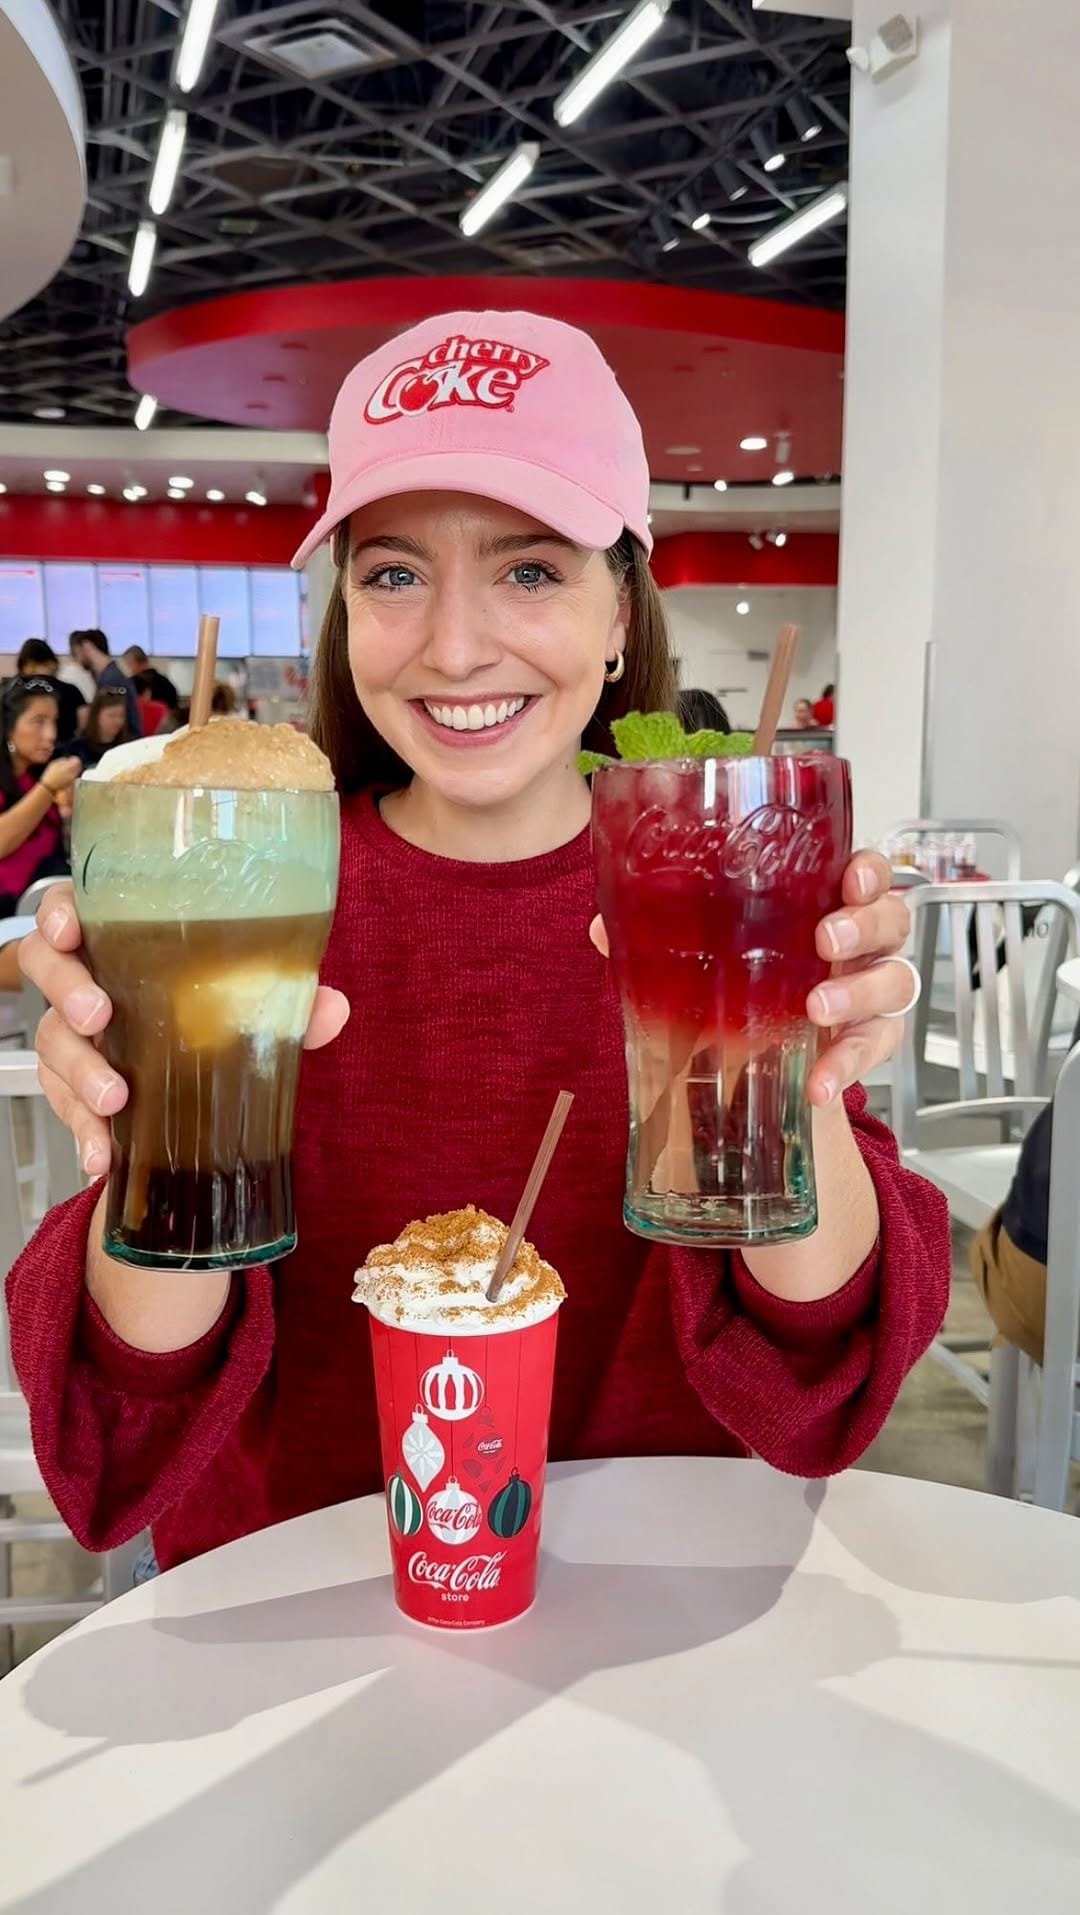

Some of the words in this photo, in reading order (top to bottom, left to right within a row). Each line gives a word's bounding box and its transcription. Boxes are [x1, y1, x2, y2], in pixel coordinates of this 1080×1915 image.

[427, 337, 546, 379] cherry
[365, 358, 518, 423] Coke
[408, 1550, 508, 1591] Coca-Cola
[441, 1593, 469, 1602] store
